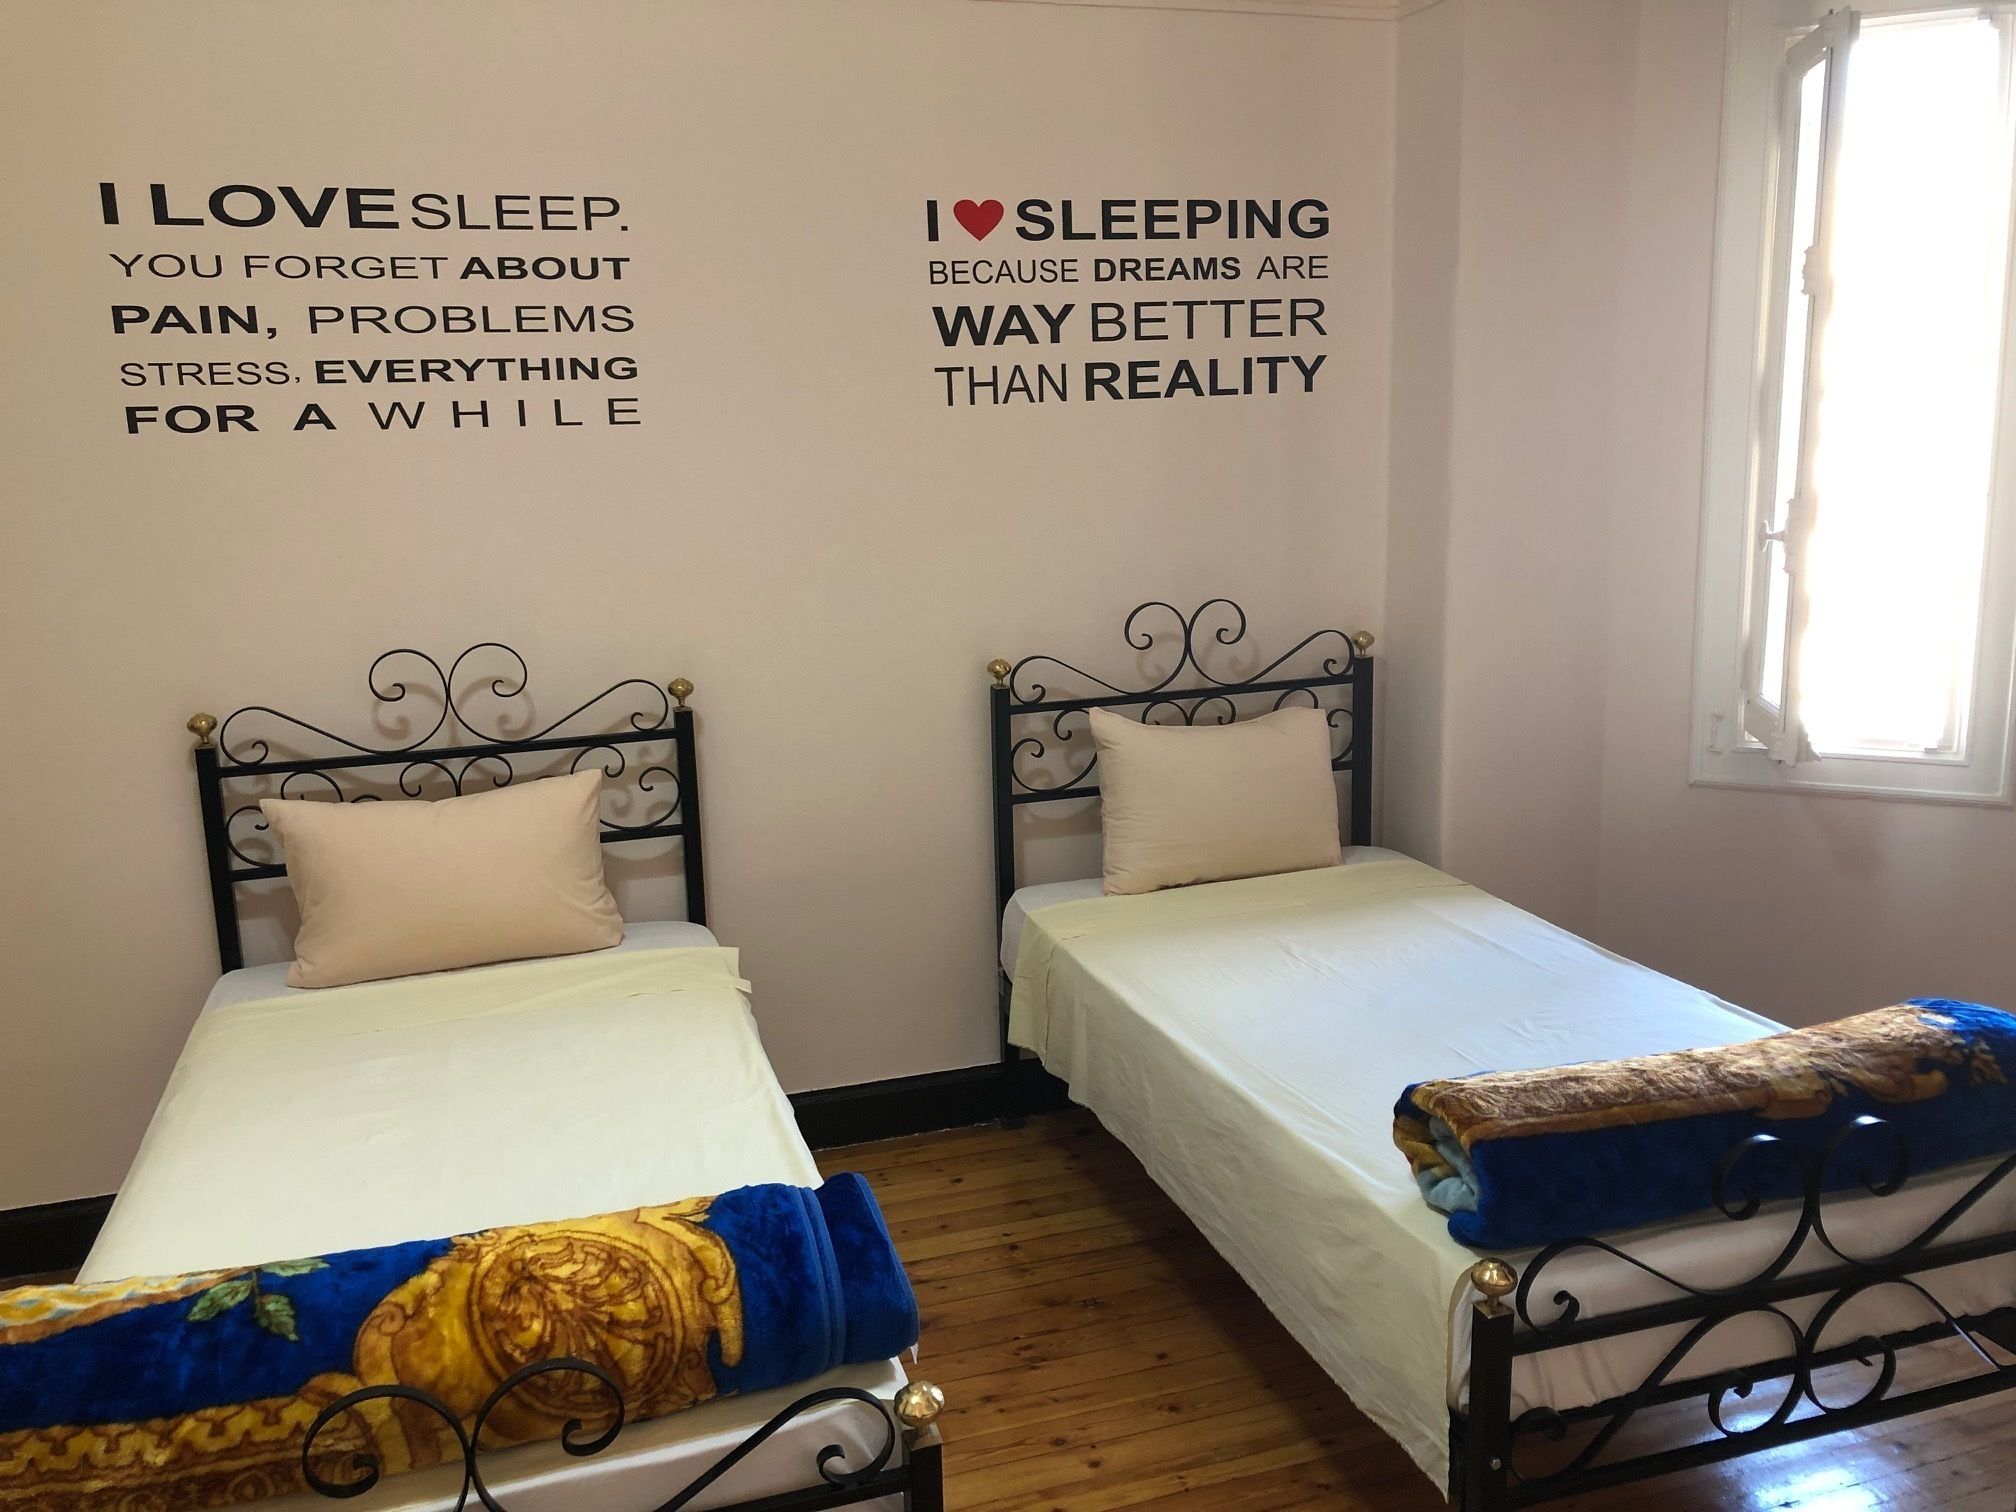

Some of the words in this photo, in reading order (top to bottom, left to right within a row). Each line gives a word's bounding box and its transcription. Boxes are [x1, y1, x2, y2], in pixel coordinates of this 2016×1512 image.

[99, 182, 120, 225] I
[149, 183, 400, 230] LOVE
[411, 193, 629, 232] SLEEP.
[926, 199, 940, 242] I
[1015, 198, 1330, 242] SLEEPING
[108, 253, 223, 279] YOU
[243, 255, 449, 280] FORGET
[459, 256, 631, 281] ABOUT
[929, 258, 1079, 285] BECAUSE
[1094, 256, 1241, 282] DREAMS
[1256, 255, 1329, 280] ARE
[111, 305, 277, 340] PAIN,
[308, 305, 635, 335] PROBLEMS
[931, 303, 1076, 347] WAY
[1091, 298, 1328, 343] BETTER
[120, 361, 301, 387] STRESS,
[314, 356, 638, 384] EVERYTHING
[934, 363, 1068, 407] THAN
[1084, 354, 1328, 402] REALITY
[124, 404, 260, 435] FOR
[293, 403, 337, 431] A
[367, 397, 641, 430] WHILE
